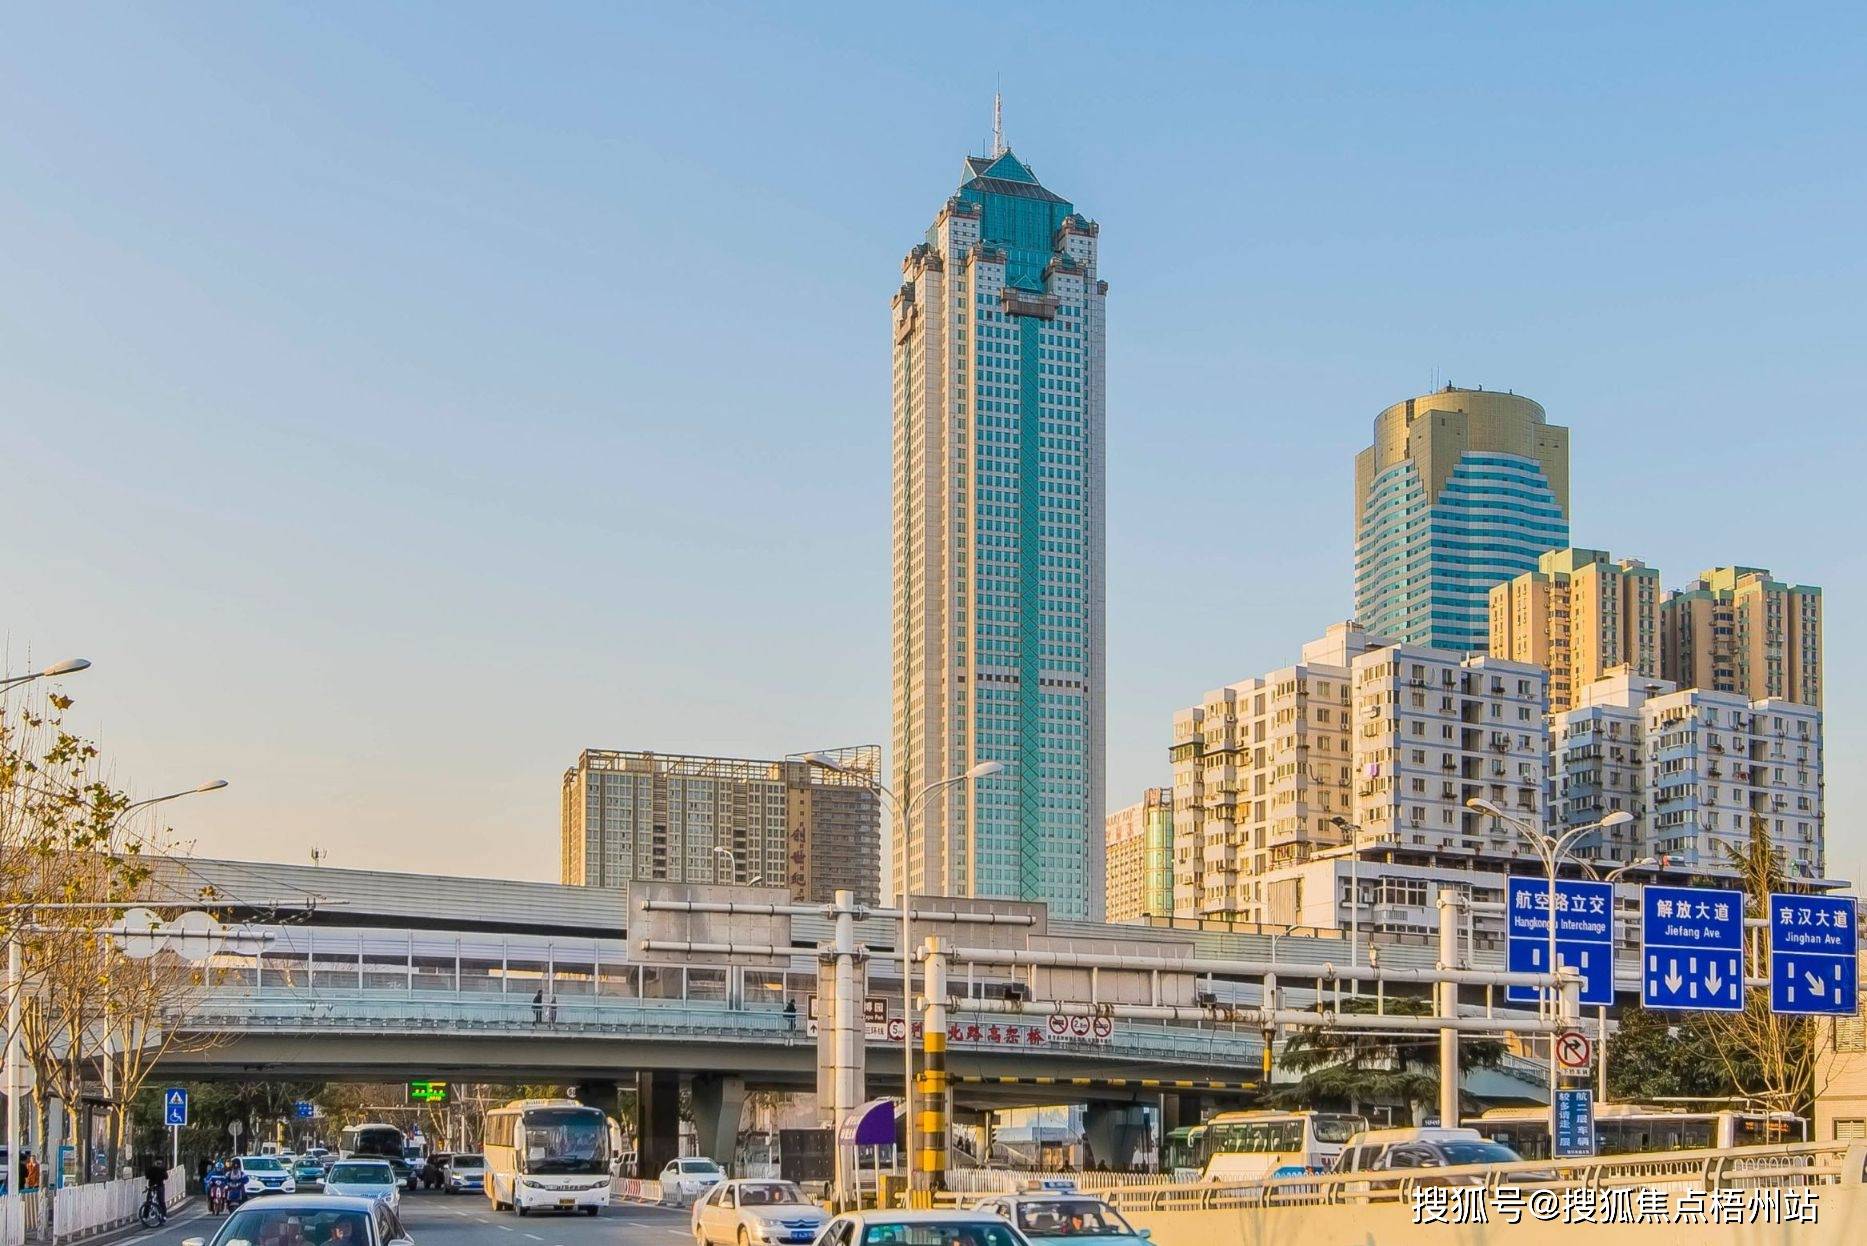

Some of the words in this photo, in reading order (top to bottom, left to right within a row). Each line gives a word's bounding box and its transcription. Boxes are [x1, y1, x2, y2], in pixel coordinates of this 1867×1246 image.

[1515, 889, 1605, 915] 航空路立交
[1657, 899, 1729, 921] 解放大道
[1560, 918, 1606, 935] Interchange
[1779, 906, 1848, 929] 京汉大道
[1664, 924, 1700, 940] Jiefang
[1703, 927, 1722, 939] Ave.
[1785, 932, 1821, 946] Jinghan
[1824, 934, 1843, 945] Ave.
